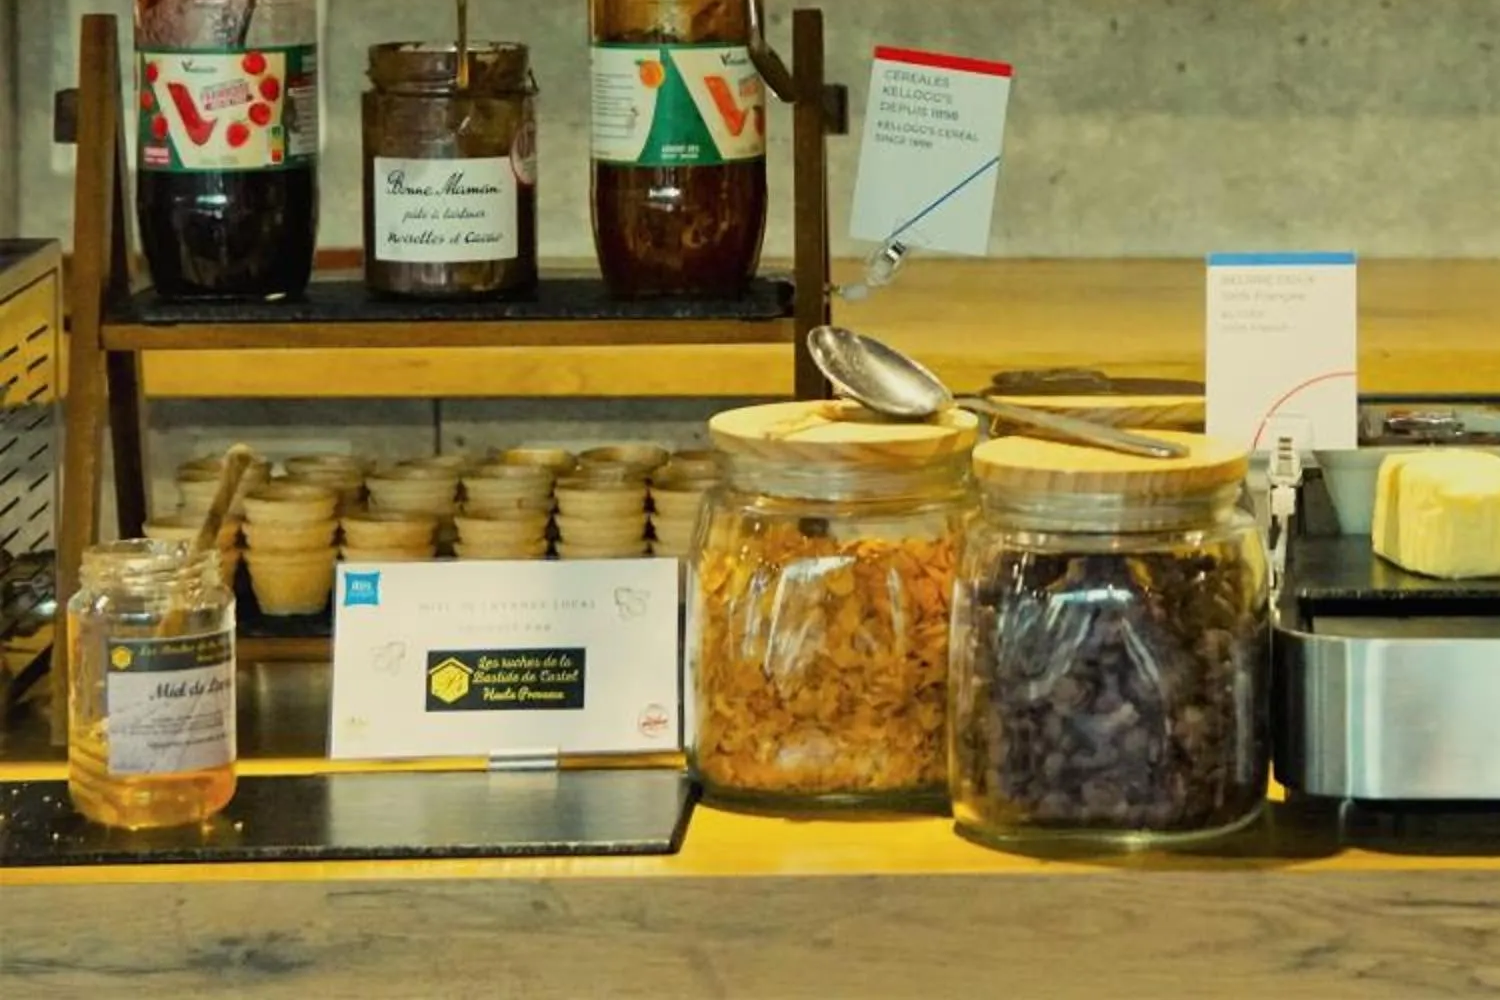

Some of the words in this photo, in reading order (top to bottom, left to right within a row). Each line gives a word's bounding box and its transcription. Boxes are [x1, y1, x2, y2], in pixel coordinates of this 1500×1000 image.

[879, 101, 928, 117] DEPUIS
[386, 169, 433, 196] Bonne
[435, 170, 500, 196] Maman
[478, 655, 500, 670] Les
[501, 656, 541, 668] ruches
[543, 654, 558, 668] de
[559, 654, 572, 667] la
[521, 671, 537, 682] de
[149, 681, 188, 701] Miel
[189, 680, 205, 697] de
